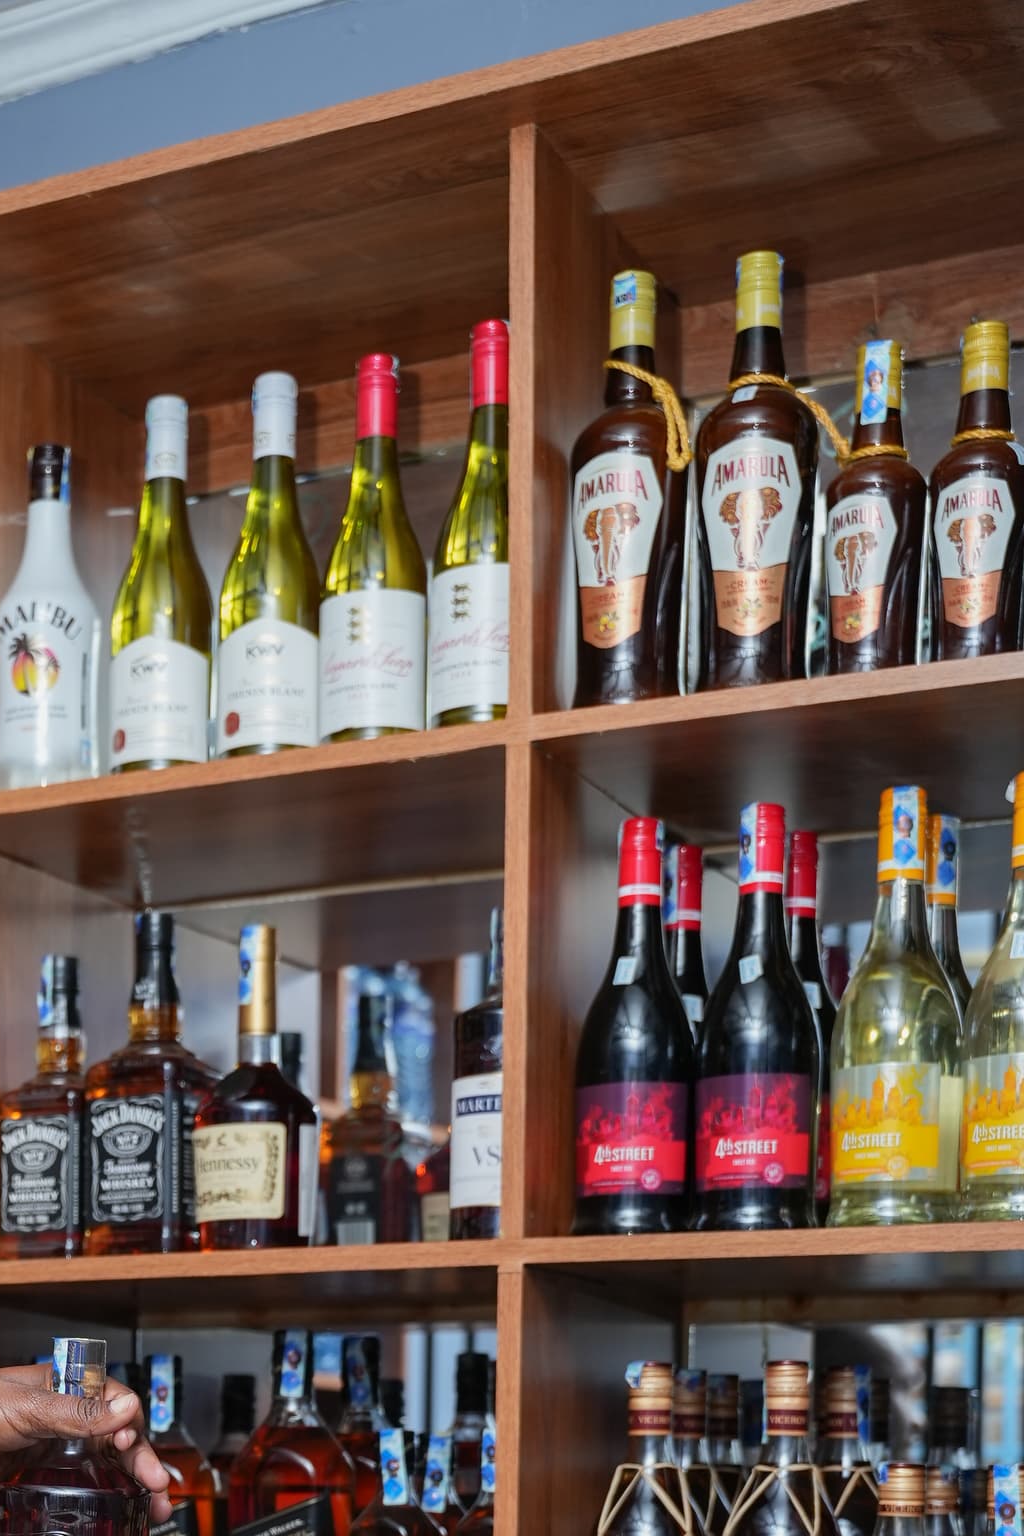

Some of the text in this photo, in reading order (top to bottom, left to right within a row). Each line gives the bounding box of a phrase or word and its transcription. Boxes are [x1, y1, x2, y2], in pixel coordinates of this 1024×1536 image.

[711, 455, 790, 496] AMARULA
[577, 470, 649, 512] AMARULA
[942, 488, 1003, 522] AMARULA
[831, 504, 884, 537] AMARULA
[457, 1095, 502, 1115] MARTE
[841, 1132, 902, 1152] 4th STREET
[972, 1124, 1024, 1144] 4th STREE
[594, 1145, 655, 1166] 4th STREET
[715, 1138, 778, 1159] 4th STREET
[638, 1415, 671, 1425] VICERO
[769, 1414, 808, 1425] VICEROY
